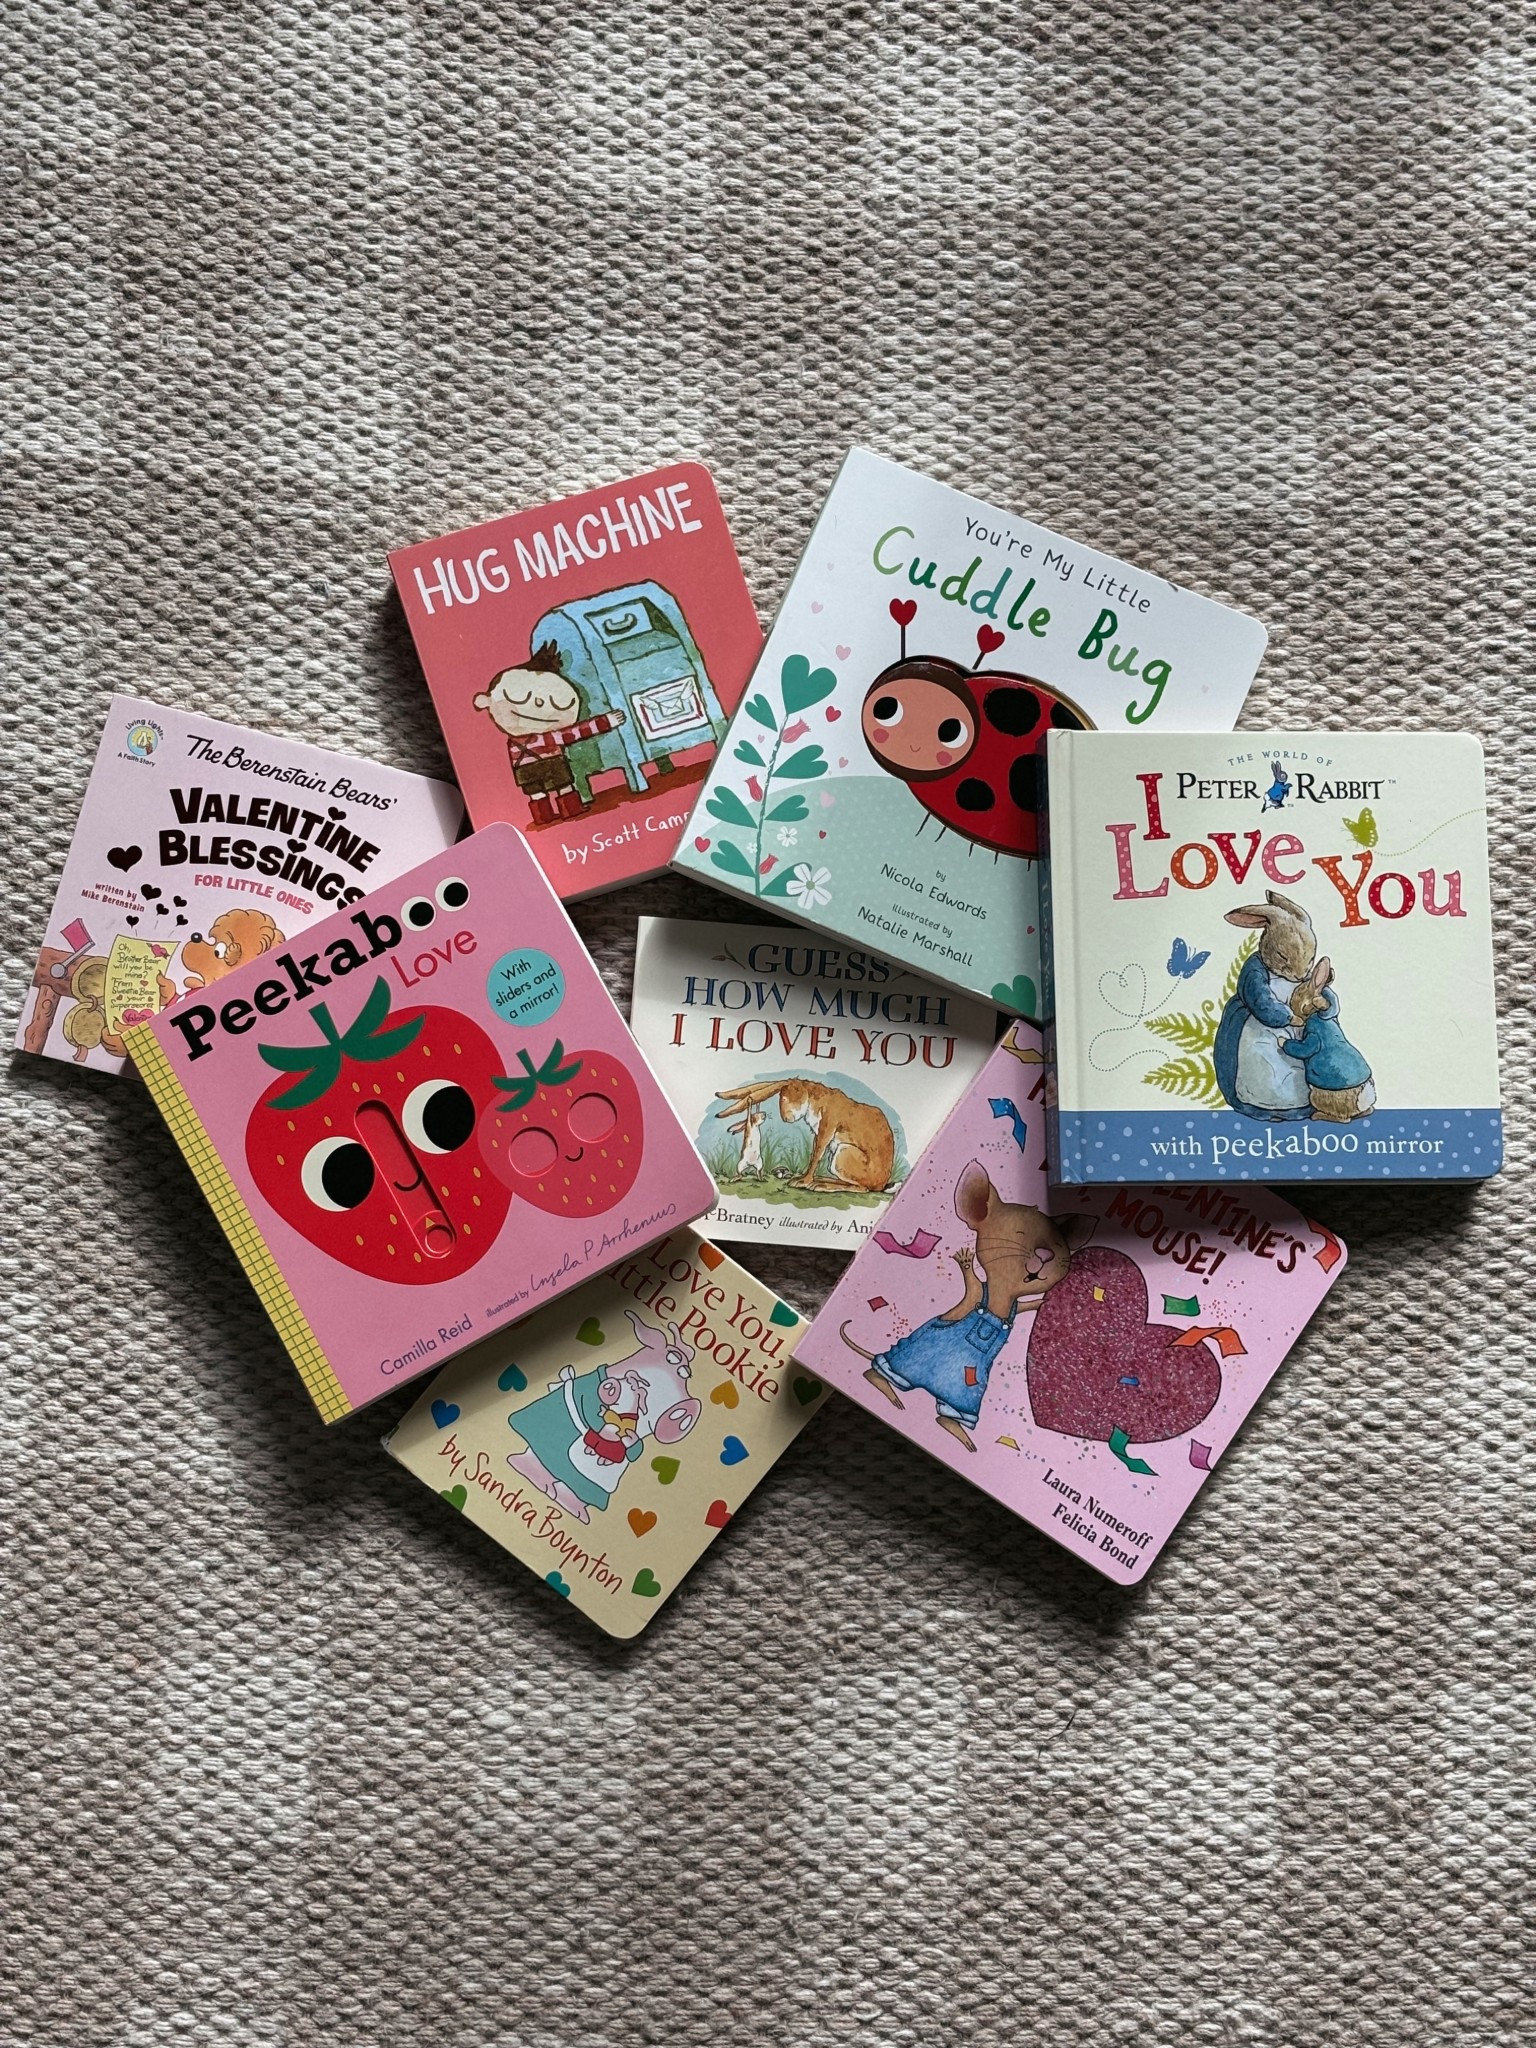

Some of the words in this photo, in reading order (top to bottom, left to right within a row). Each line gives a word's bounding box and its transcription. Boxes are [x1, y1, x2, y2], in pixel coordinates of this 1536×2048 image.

[413, 548, 511, 615] HUG
[513, 481, 703, 582] MACHINE
[965, 516, 1034, 559] You're
[1041, 548, 1076, 581] My
[1082, 567, 1152, 613] Little
[872, 525, 1051, 638] Cuddle
[1077, 607, 1173, 726] Bug
[123, 753, 139, 763] Faith
[139, 757, 156, 768] Story
[186, 734, 222, 764] The
[221, 745, 327, 794] Berenstain
[329, 777, 399, 811] Bears'
[1227, 753, 1254, 767] THE
[1261, 750, 1309, 761] WORLD
[1316, 756, 1334, 767] OF
[1135, 772, 1171, 841] I
[1175, 772, 1261, 801] PETER
[1295, 773, 1386, 804] RABBIT
[169, 787, 382, 874] VALENTINE
[561, 843, 588, 865] by
[592, 822, 640, 853] Scott
[80, 889, 101, 901] Mike
[102, 894, 146, 913] Berenstain
[95, 882, 124, 897] written
[127, 889, 138, 902] by
[194, 874, 223, 888] FOR
[226, 876, 275, 899] LITTLE
[276, 890, 315, 915] ONES
[880, 863, 924, 894] Nicola
[928, 886, 988, 921] Edwards
[935, 869, 947, 883] by
[1105, 823, 1306, 901] Love
[1312, 850, 1467, 928] You
[857, 906, 908, 939] Natalie
[912, 931, 973, 967] Marshall
[892, 903, 941, 931] Illustrated
[943, 925, 953, 939] by
[390, 930, 478, 989] Love
[496, 982, 532, 1007] sliders
[533, 962, 556, 985] and
[500, 959, 532, 980] With
[748, 943, 891, 983] GUESS
[509, 1009, 518, 1019] a
[520, 982, 560, 1013] mirror!
[681, 976, 795, 1013] HOW
[808, 986, 951, 1026] MUCH
[669, 1013, 688, 1047] I
[706, 1016, 837, 1060] LOVE
[851, 1028, 958, 1069] YOU
[1150, 1134, 1204, 1157] with
[1211, 1127, 1359, 1165] peekaboo
[1366, 1137, 1444, 1155] mirror
[778, 1216, 829, 1231] illustrated
[830, 1220, 843, 1233] by
[1105, 1187, 1227, 1285] MOUSE!
[647, 1236, 726, 1311] Love
[725, 1293, 785, 1370] You,
[380, 1337, 438, 1376] Camilla
[437, 1313, 473, 1343] Reid
[485, 1290, 520, 1318] illustrated
[518, 1290, 530, 1304] by
[678, 1305, 779, 1403] Pookie
[438, 1434, 467, 1478] by
[464, 1452, 538, 1529] Sandra
[531, 1505, 623, 1595] Boynton
[1042, 1467, 1082, 1504] Laura
[1082, 1496, 1154, 1550] Numeroff
[1052, 1502, 1097, 1544] Felicia
[1098, 1534, 1139, 1570] Bond
